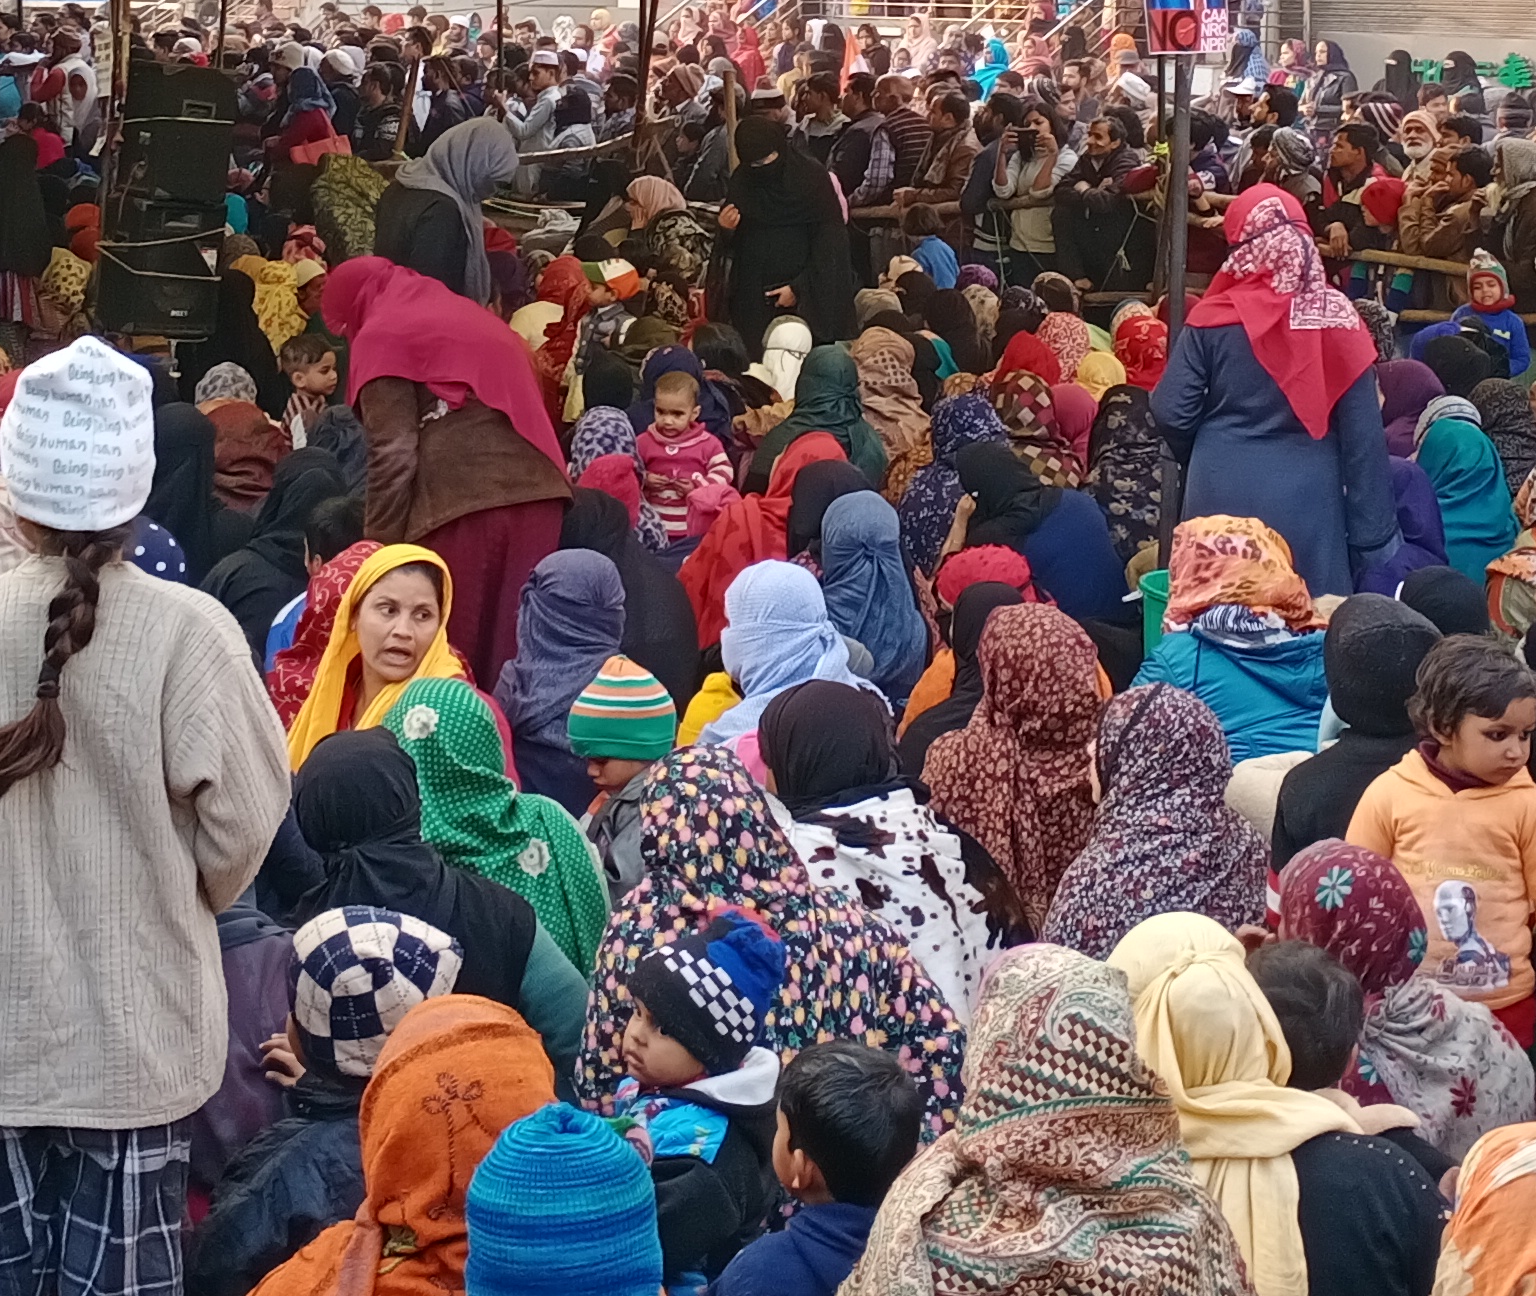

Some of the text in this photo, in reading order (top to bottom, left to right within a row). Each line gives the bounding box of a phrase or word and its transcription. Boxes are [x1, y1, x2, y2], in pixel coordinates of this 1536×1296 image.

[1201, 9, 1228, 23] CAA
[1150, 9, 1199, 52] NO
[1200, 23, 1228, 37] NRC
[1200, 38, 1227, 52] NPR
